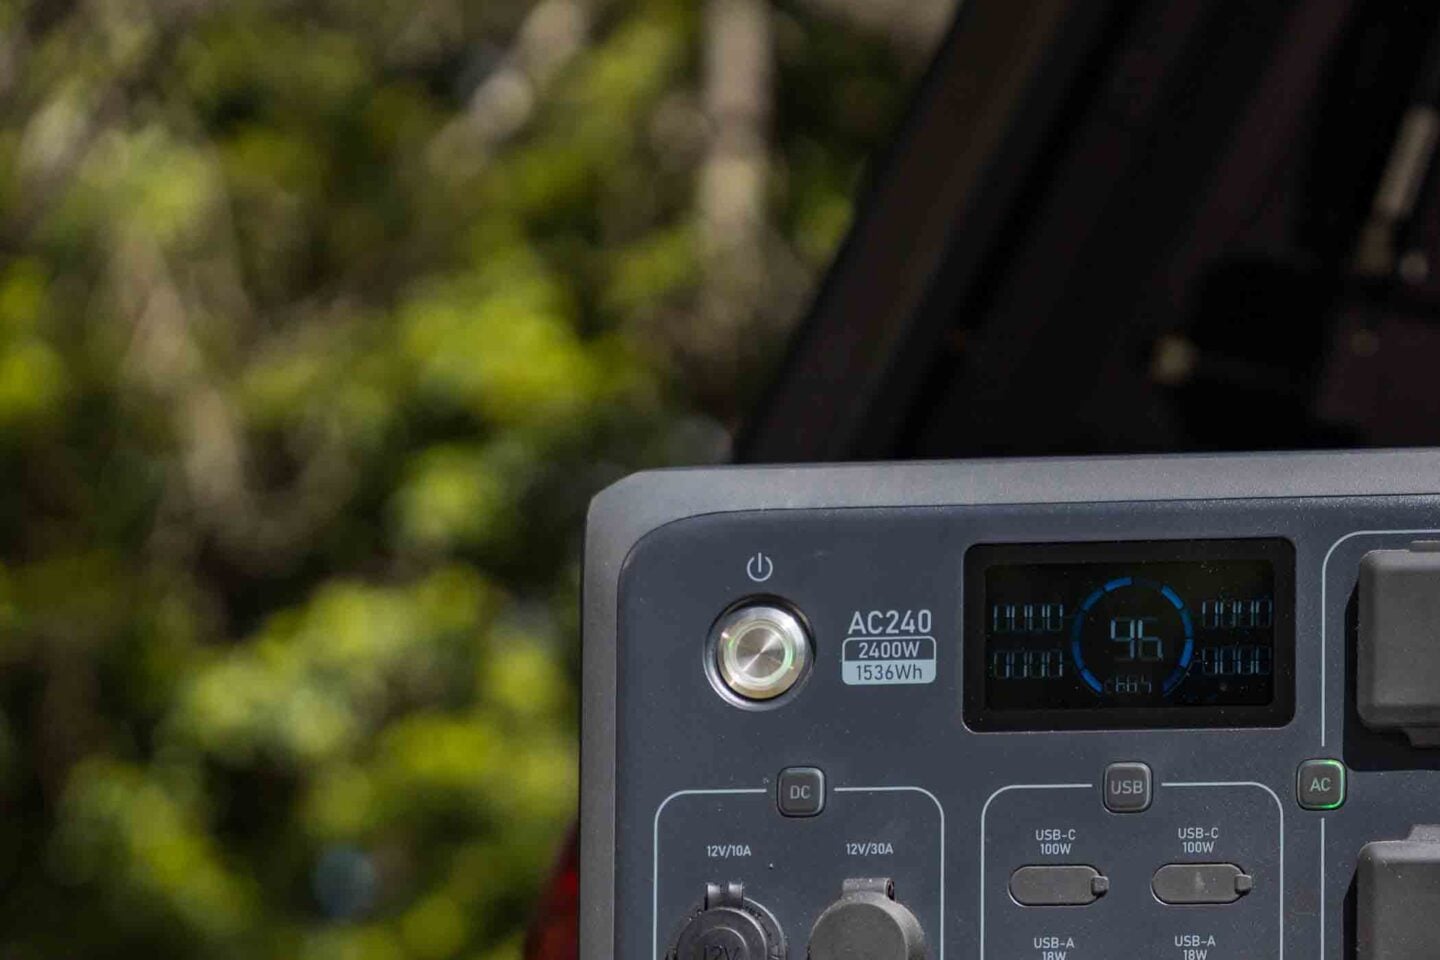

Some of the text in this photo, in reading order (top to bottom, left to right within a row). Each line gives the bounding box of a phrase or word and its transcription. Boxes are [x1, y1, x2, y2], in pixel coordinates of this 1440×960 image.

[847, 609, 932, 635] AC240
[858, 641, 920, 659] 2400W
[856, 663, 923, 681] 1536Wh
[1111, 780, 1143, 795] USB
[1309, 777, 1331, 792] AC
[789, 784, 811, 800] DC
[1035, 828, 1077, 841] USB-C
[1177, 827, 1219, 840] USB-C
[707, 844, 752, 859] 12V/10A
[846, 842, 894, 856] 12V/30A
[1039, 842, 1073, 855] 100W
[1182, 841, 1215, 853] 100W
[1033, 937, 1075, 949] USB-A
[1174, 935, 1216, 947] USB-A
[1183, 949, 1208, 960] 18W
